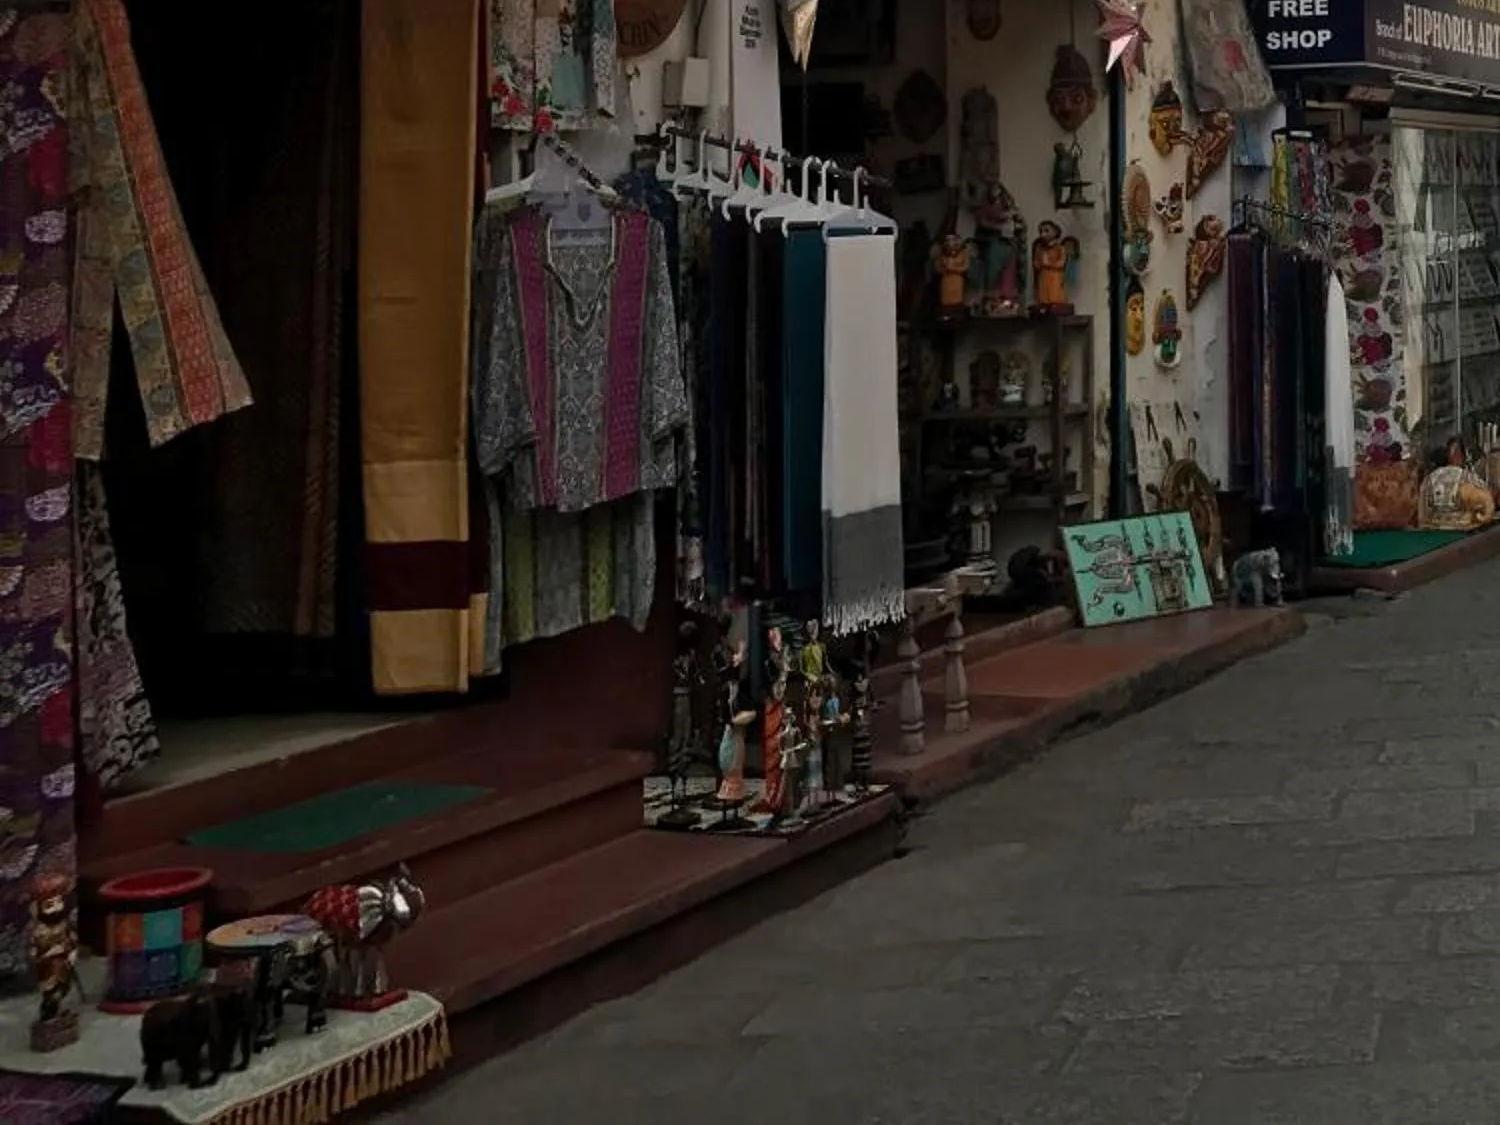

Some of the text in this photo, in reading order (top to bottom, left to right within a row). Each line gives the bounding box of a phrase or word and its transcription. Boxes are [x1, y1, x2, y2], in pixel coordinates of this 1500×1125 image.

[1268, 0, 1329, 18] FREE
[1403, 3, 1475, 54] EUPHORIA
[1266, 29, 1332, 50] SHOP
